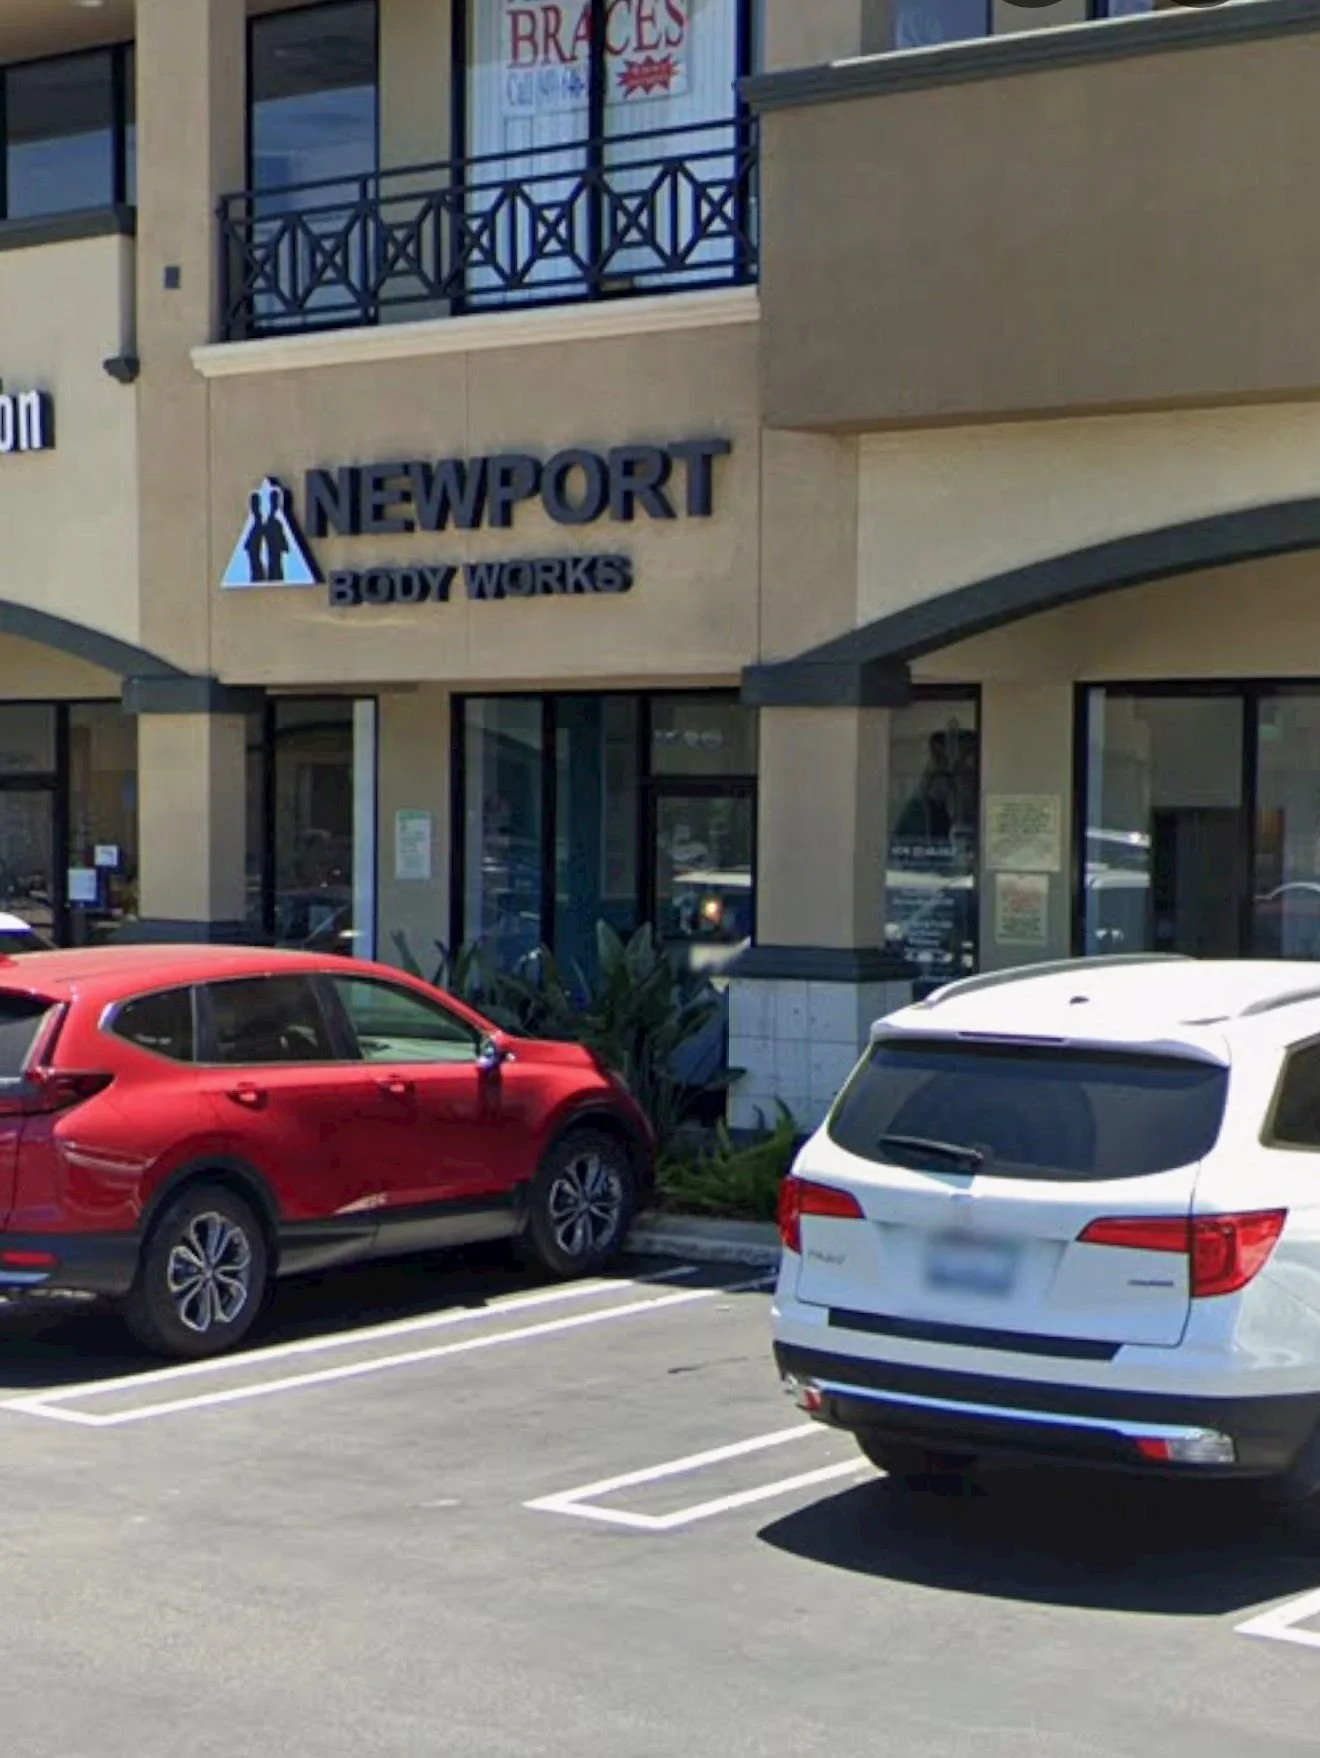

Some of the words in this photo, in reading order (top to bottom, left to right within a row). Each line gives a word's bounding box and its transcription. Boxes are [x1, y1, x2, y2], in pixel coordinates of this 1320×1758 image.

[505, 0, 690, 69] BRACES
[304, 438, 731, 538] NEWPORT
[329, 565, 457, 606] BODY
[464, 554, 634, 600] WORKS
